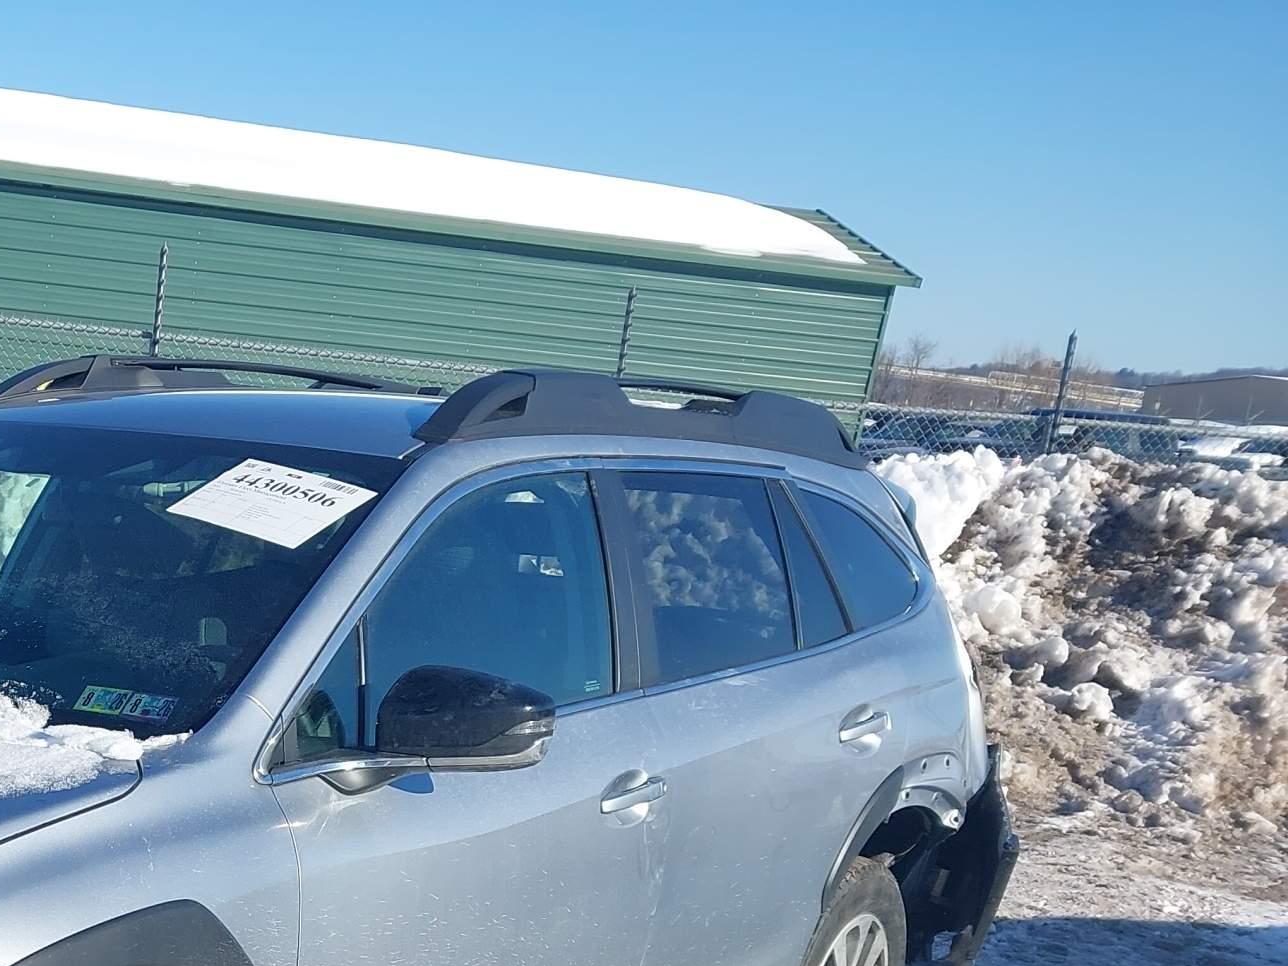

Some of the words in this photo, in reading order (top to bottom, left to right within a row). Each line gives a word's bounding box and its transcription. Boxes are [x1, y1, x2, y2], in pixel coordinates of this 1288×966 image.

[232, 473, 342, 507] 44300506
[82, 691, 95, 706] 8
[130, 698, 142, 713] 8
